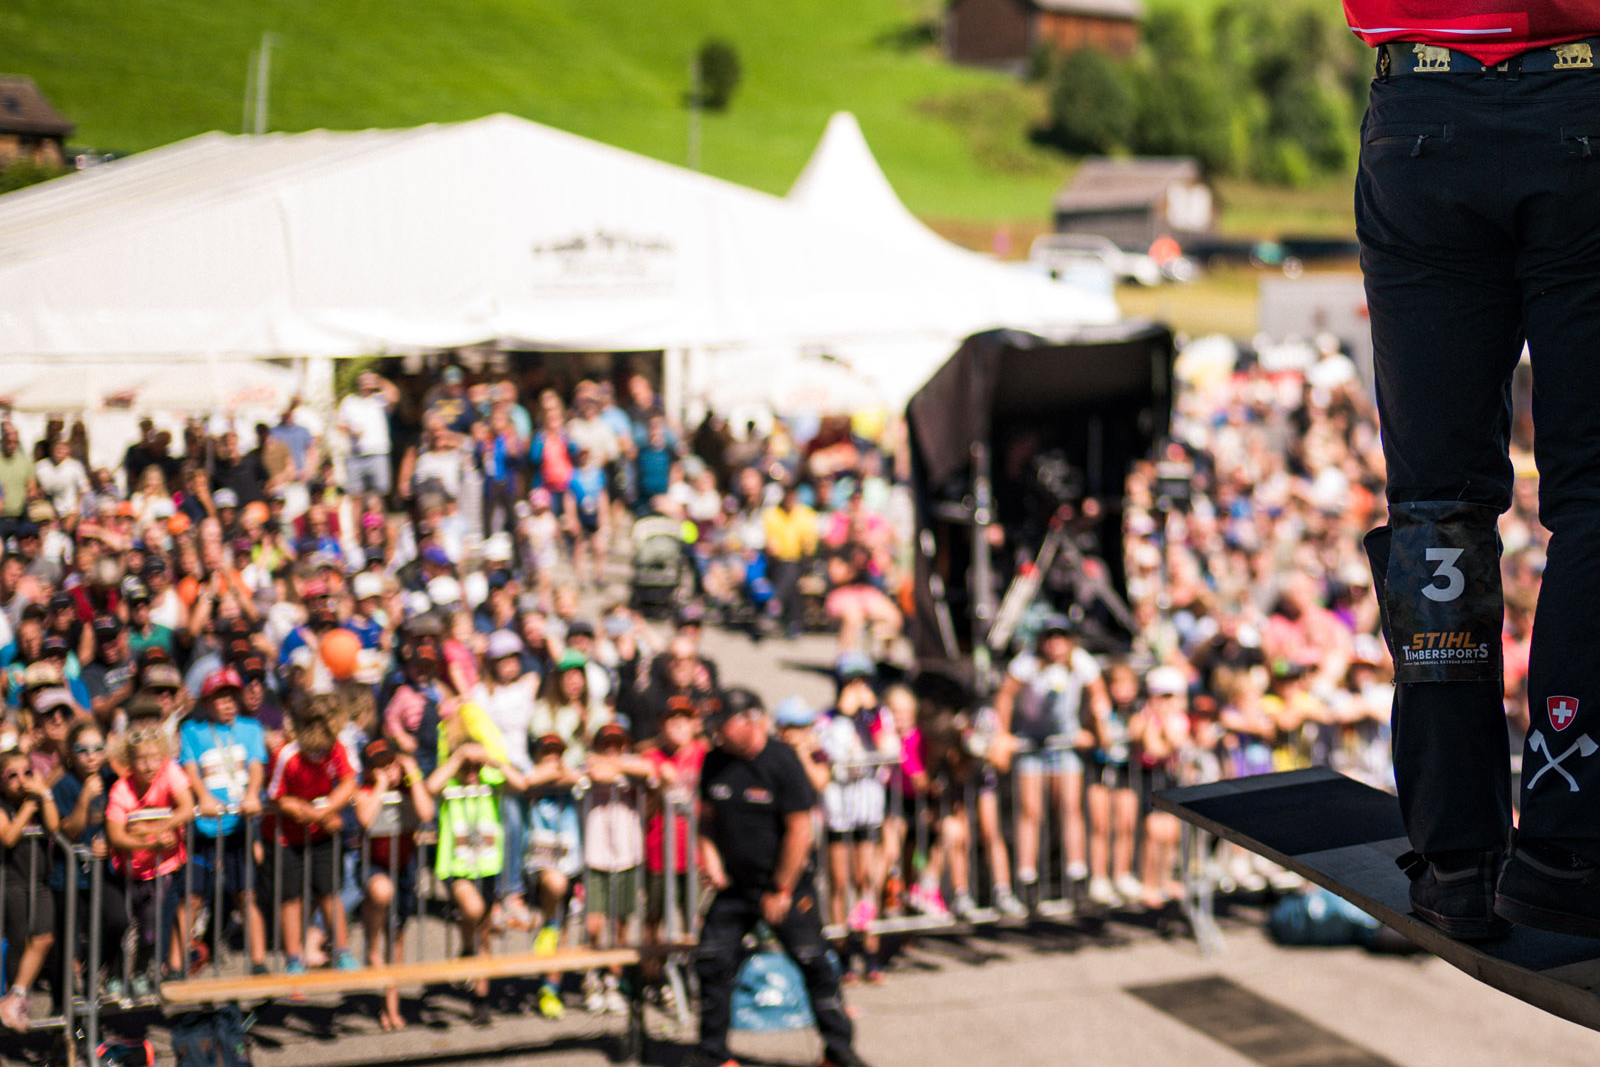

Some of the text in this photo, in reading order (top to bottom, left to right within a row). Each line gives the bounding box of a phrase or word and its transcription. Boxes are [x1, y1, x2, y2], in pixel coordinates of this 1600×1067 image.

[1420, 547, 1466, 603] 3
[1411, 631, 1478, 650] STIHL
[1402, 643, 1489, 661] TIMBERSPORTS
